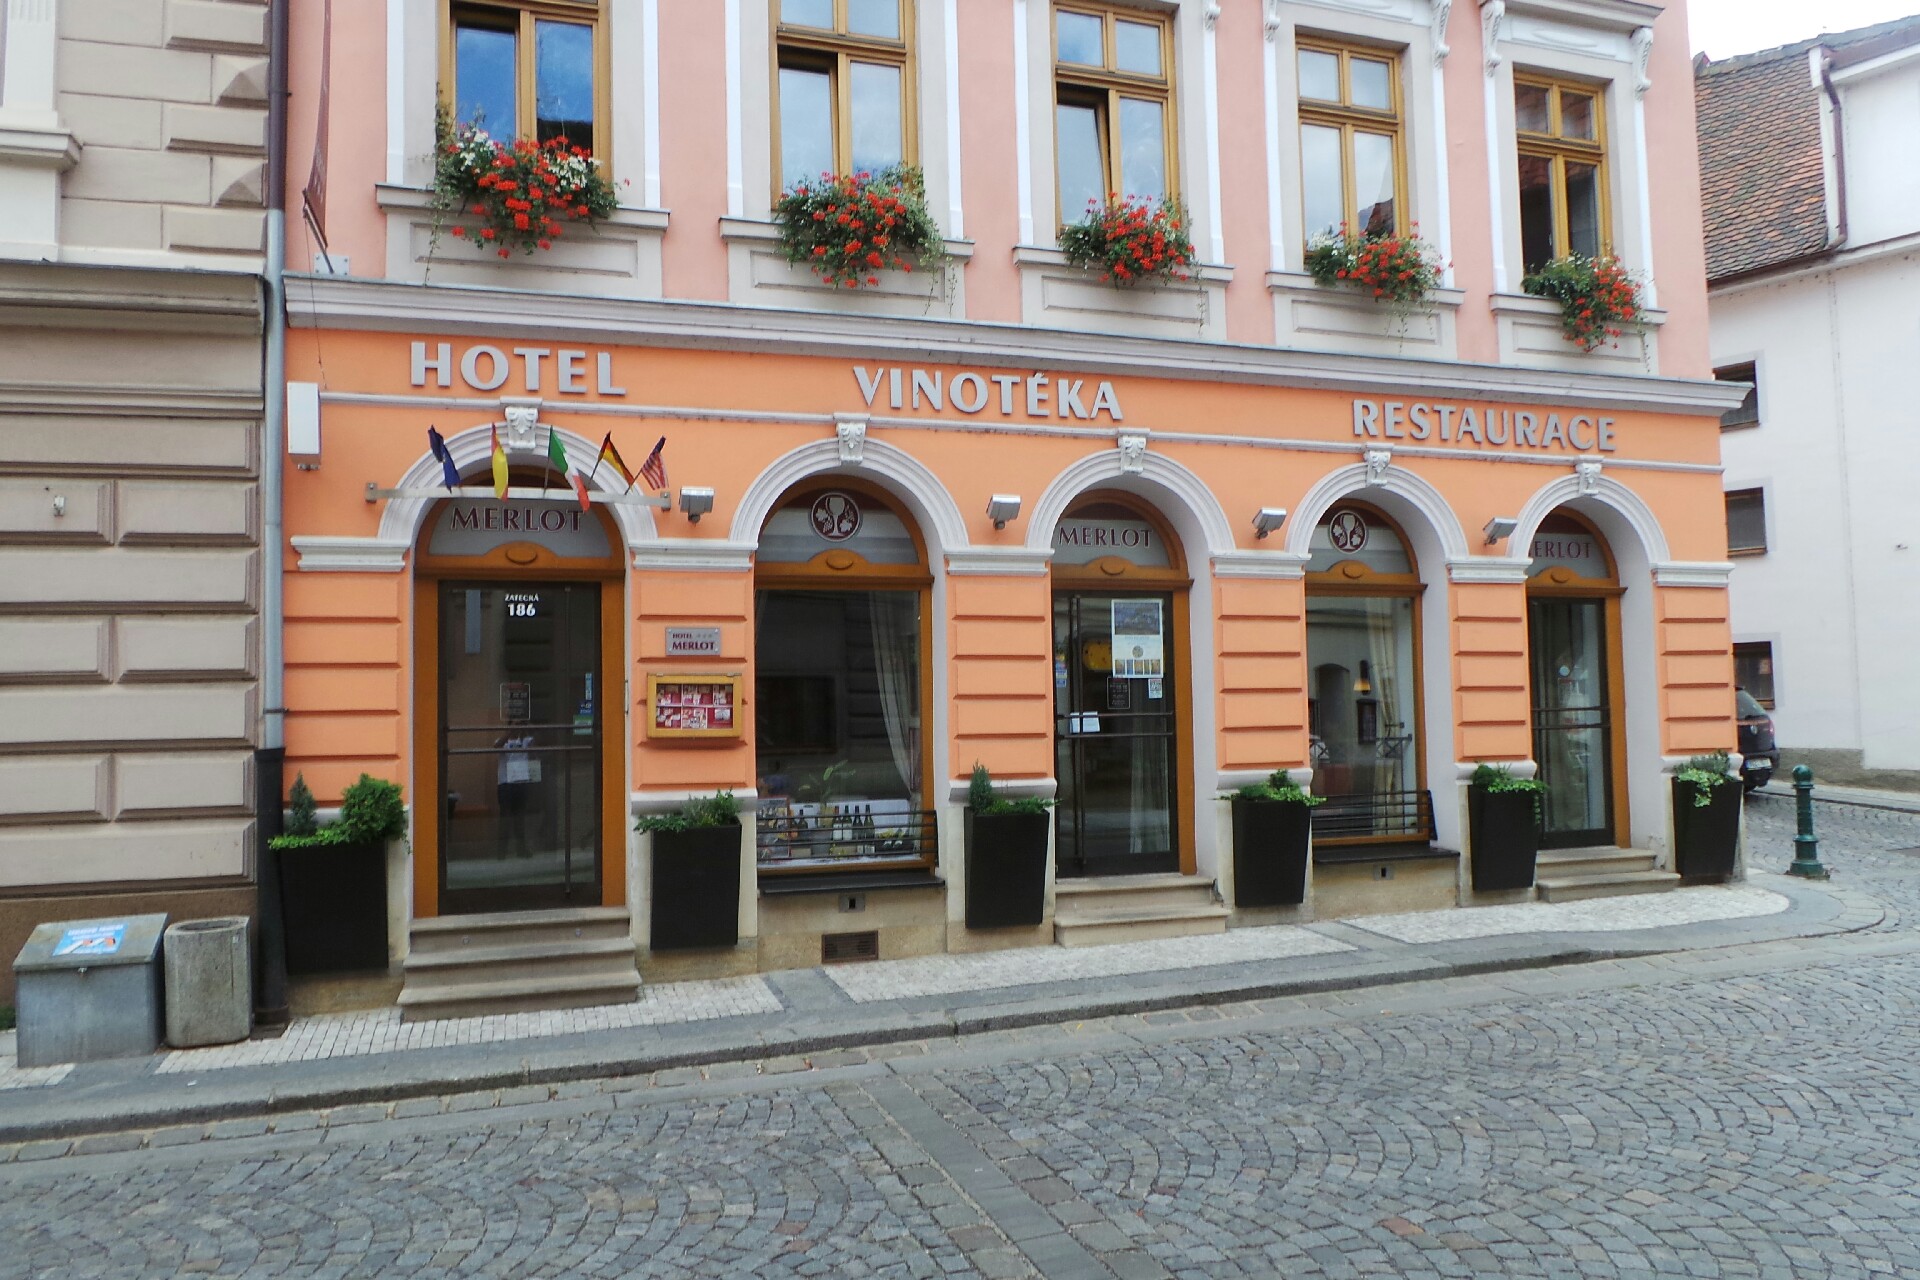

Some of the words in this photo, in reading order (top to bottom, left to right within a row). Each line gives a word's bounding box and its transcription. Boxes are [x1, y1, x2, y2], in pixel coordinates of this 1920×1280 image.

[410, 341, 626, 395] HOTEL
[853, 366, 1123, 420] VINOTÉKA
[1353, 399, 1616, 451] RESTAURACE
[451, 506, 584, 533] MERLOT
[1058, 526, 1152, 548] MERLOT
[1530, 540, 1593, 559] ERLOT
[507, 602, 536, 617] 186
[672, 641, 715, 651] MERLOT
